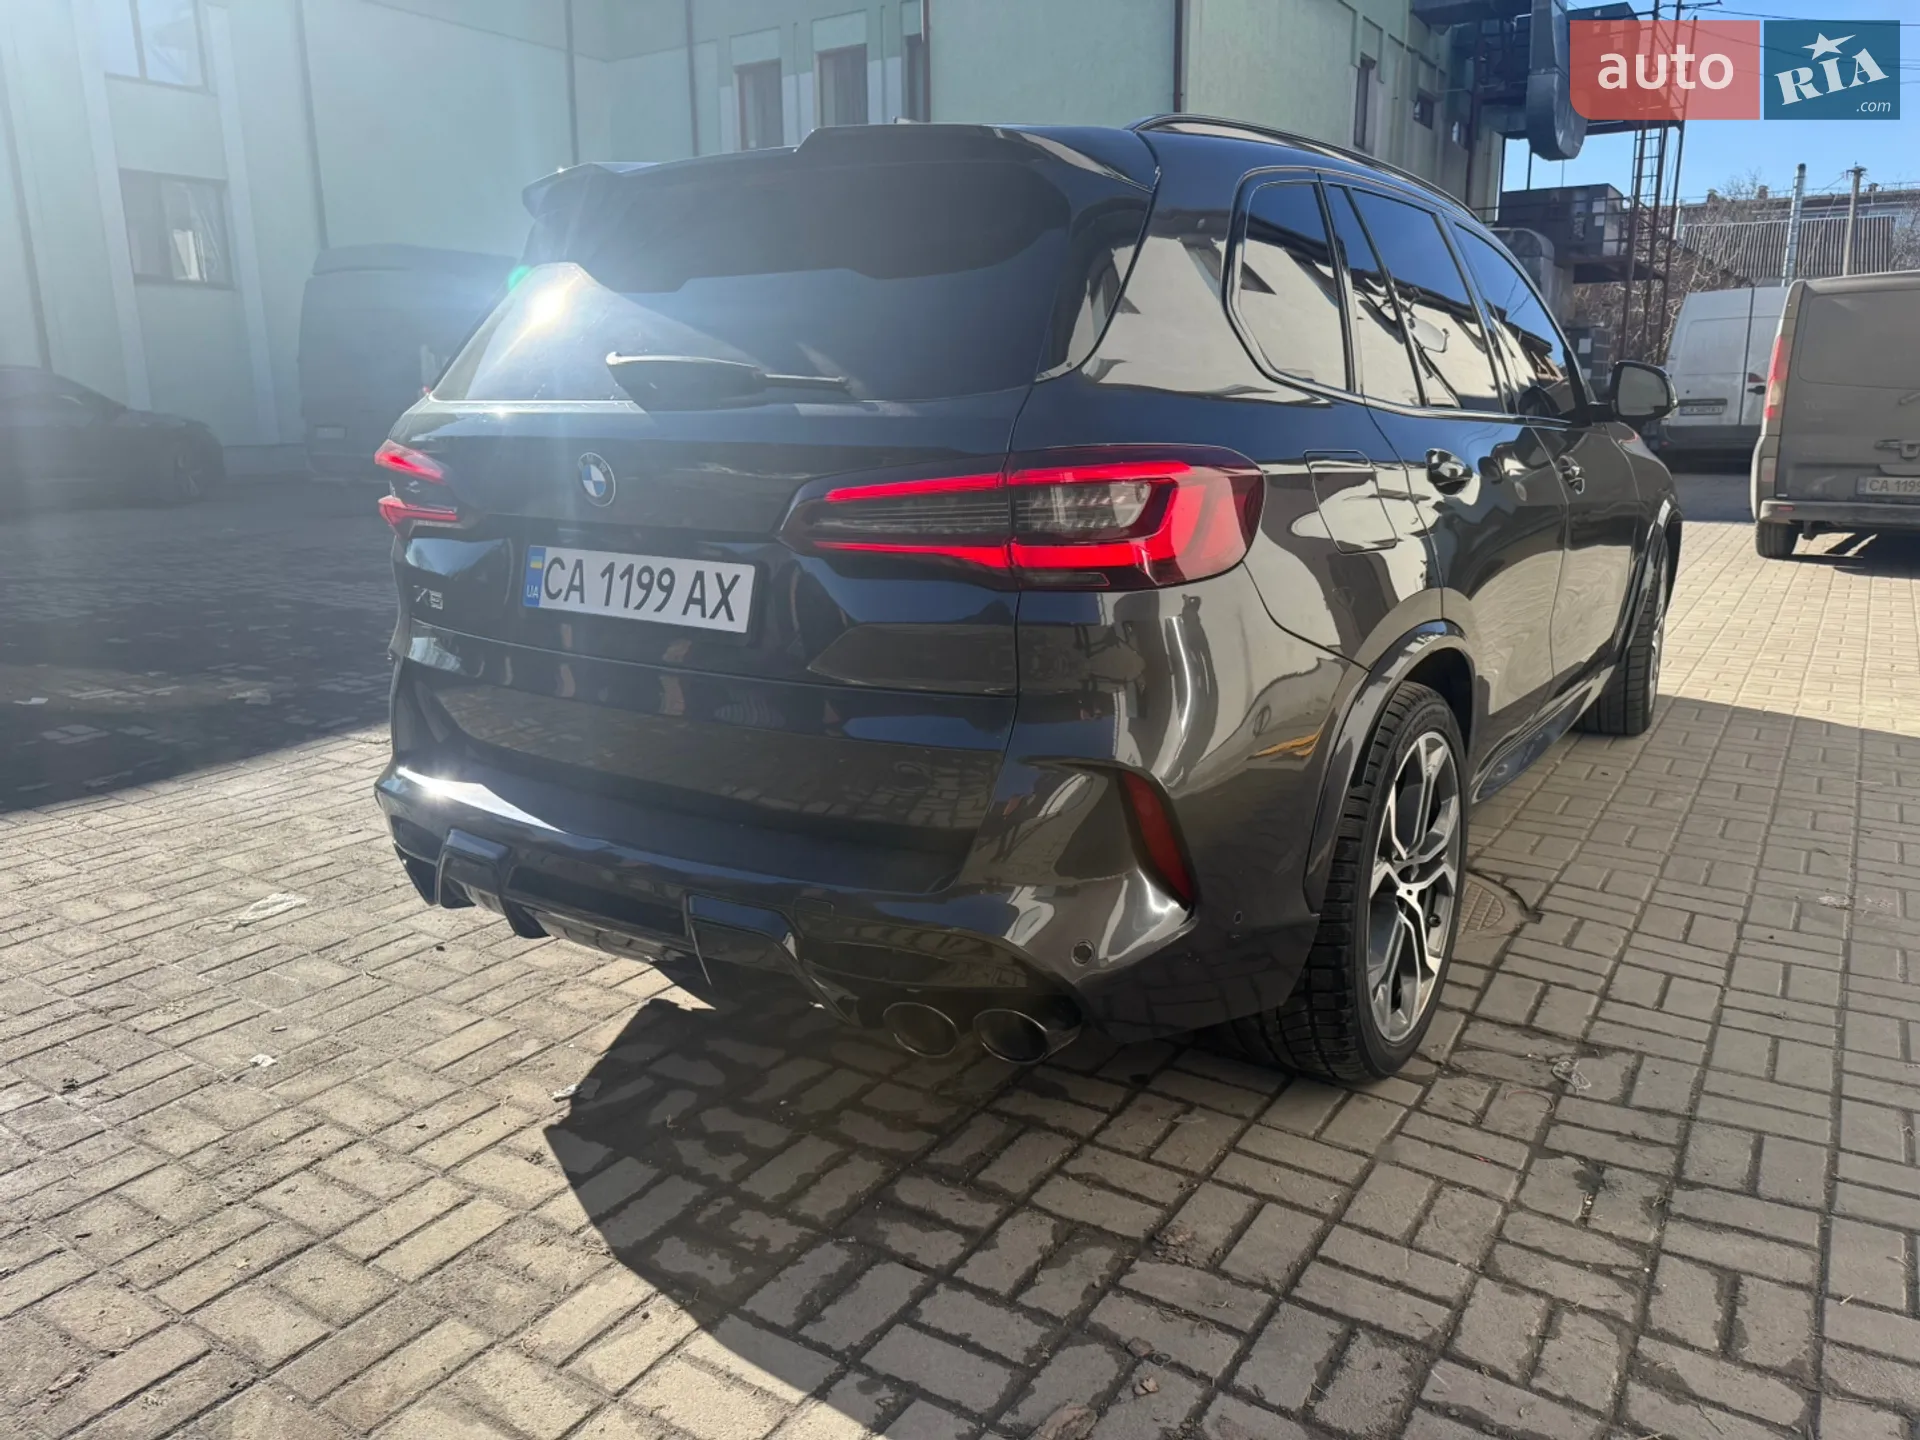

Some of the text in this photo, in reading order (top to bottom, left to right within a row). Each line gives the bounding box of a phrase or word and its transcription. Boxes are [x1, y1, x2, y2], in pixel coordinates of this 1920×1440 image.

[1869, 479, 1889, 492] CA
[526, 585, 539, 599] UA
[543, 556, 741, 622] CA 1199 AX
